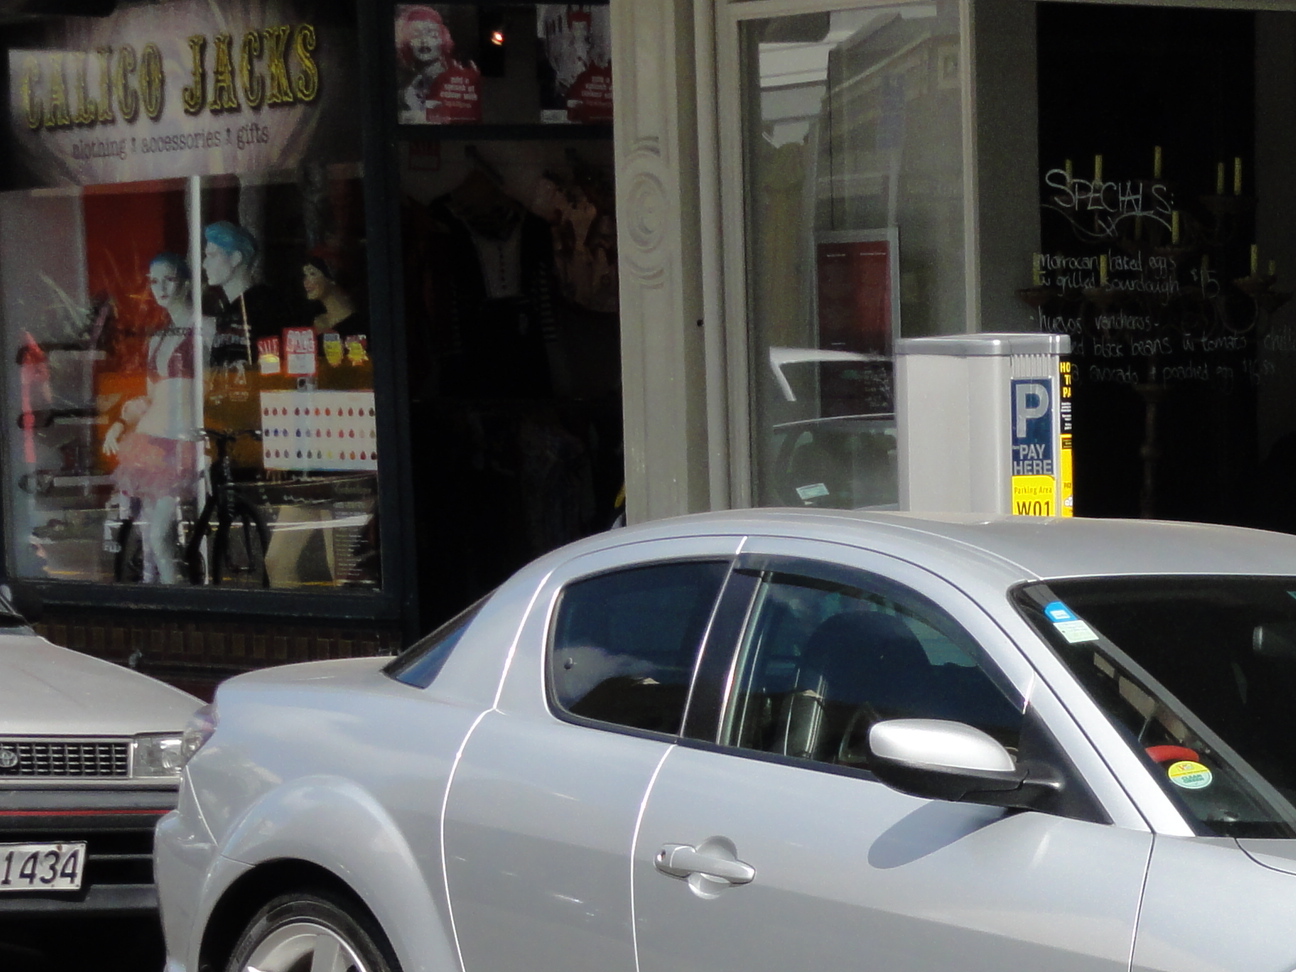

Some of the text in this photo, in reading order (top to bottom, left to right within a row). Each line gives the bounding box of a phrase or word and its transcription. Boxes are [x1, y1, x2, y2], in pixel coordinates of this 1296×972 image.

[21, 24, 319, 130] CALICO JACKS
[73, 123, 270, 160] clothing accessories gifts
[1015, 384, 1049, 438] P
[1019, 444, 1046, 460] PAY
[1013, 460, 1052, 475] HERE
[1014, 486, 1037, 496] Parking
[1038, 485, 1053, 494] Area
[1016, 501, 1051, 517] W01
[0, 849, 80, 886] 1434
